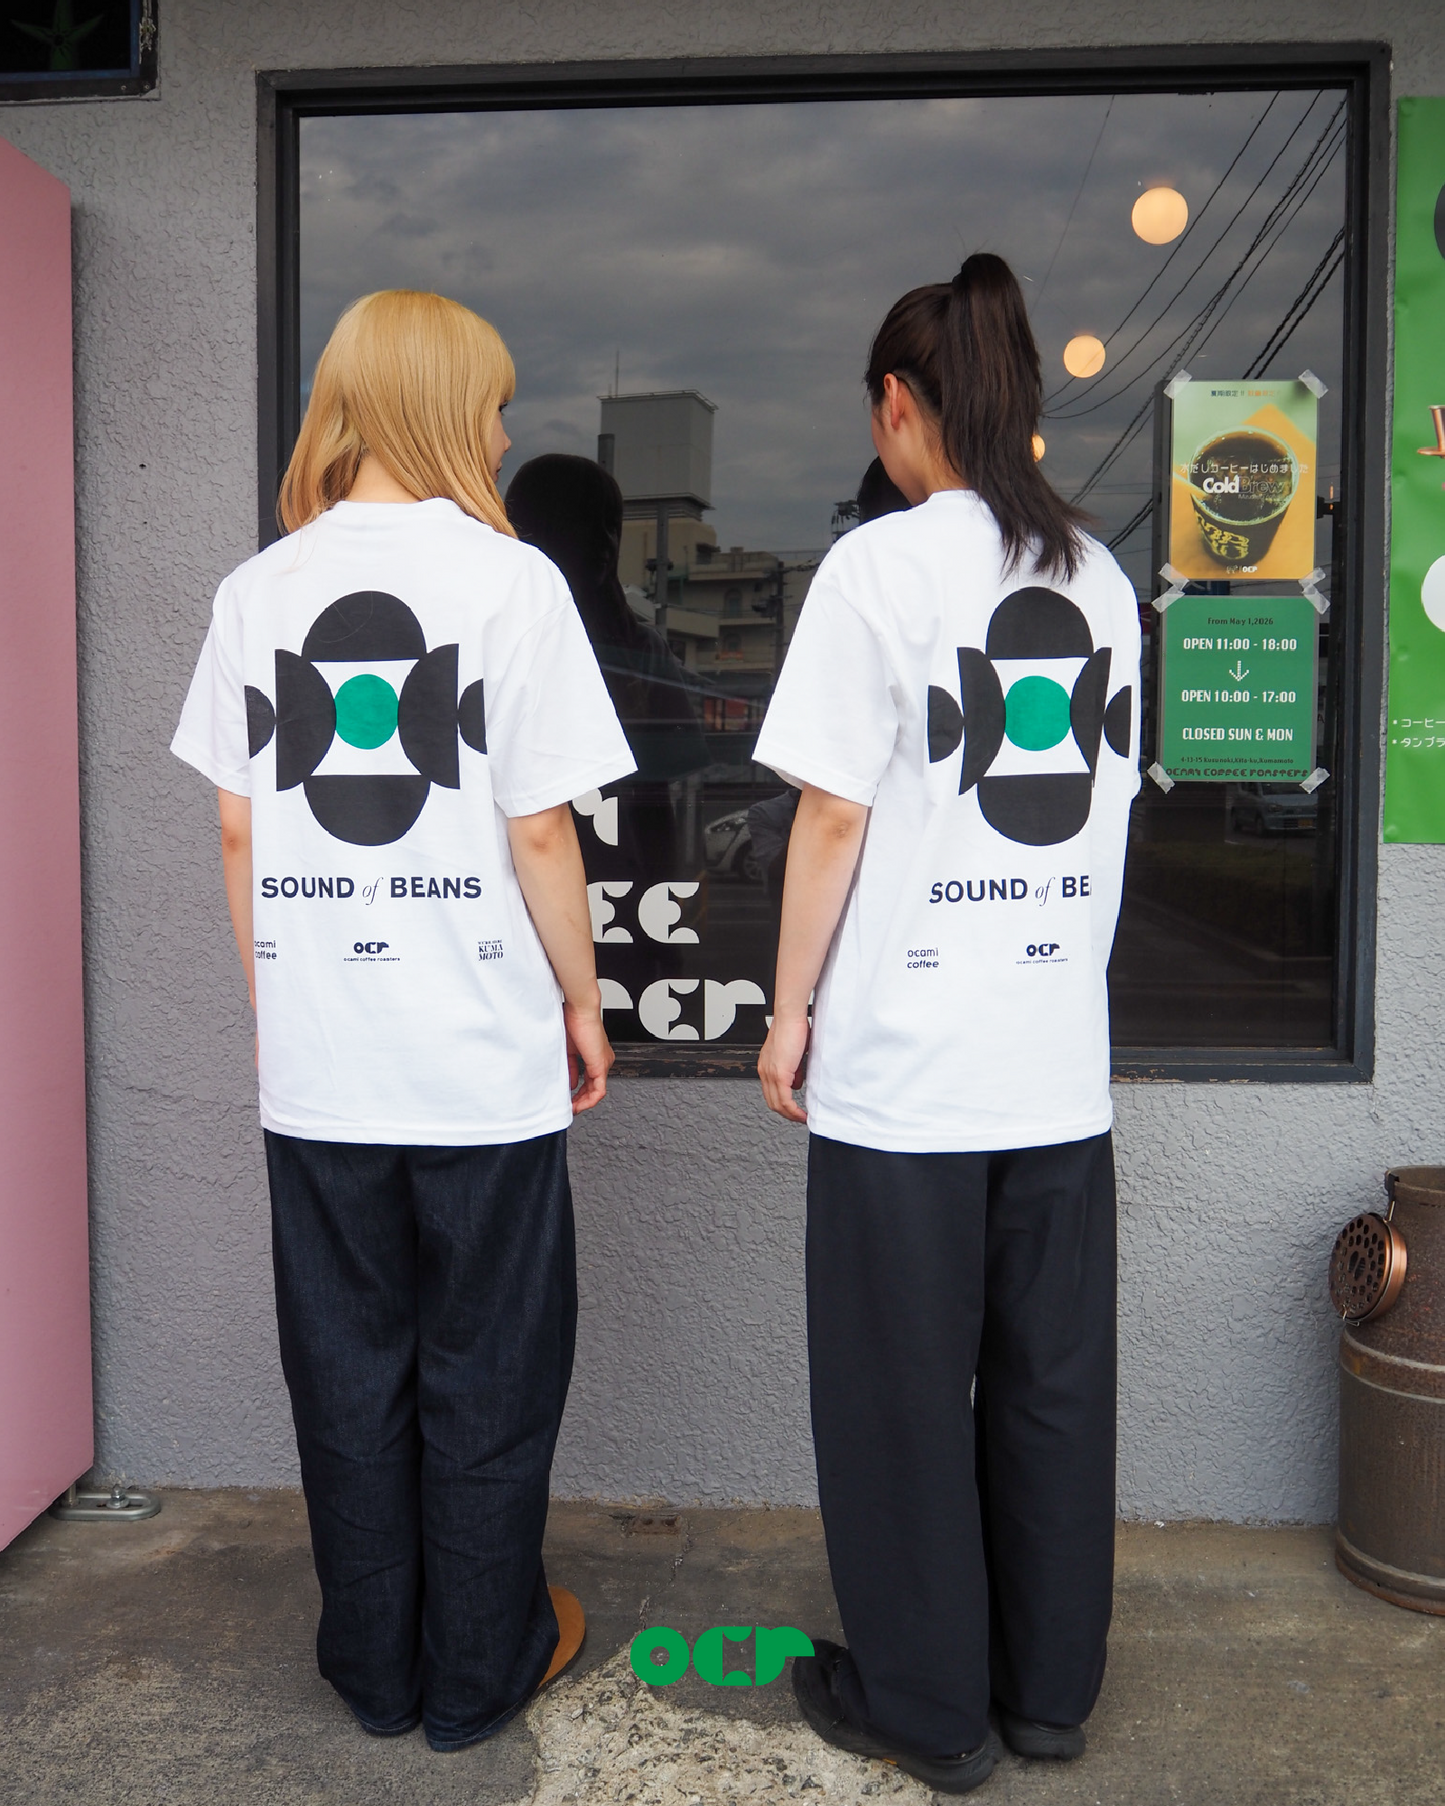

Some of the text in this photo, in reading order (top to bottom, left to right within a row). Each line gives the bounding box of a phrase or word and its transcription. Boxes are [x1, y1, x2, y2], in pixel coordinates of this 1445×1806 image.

[1202, 475, 1239, 494] Cold
[1207, 617, 1228, 626] From
[1229, 617, 1246, 627] May
[1183, 637, 1214, 651] OPEN
[1216, 637, 1250, 651] 11:00
[1262, 638, 1297, 652] 18:00
[1181, 689, 1212, 703] OPEN
[1214, 690, 1250, 703] 10:00
[1262, 690, 1296, 703] 17:00
[1182, 727, 1293, 741] CLOSED SUN & MON
[261, 876, 482, 906] SOUND of BEANS
[929, 878, 1028, 904] SOUND
[1035, 876, 1056, 907] of
[907, 947, 939, 958] ocami
[907, 960, 940, 969] coffee
